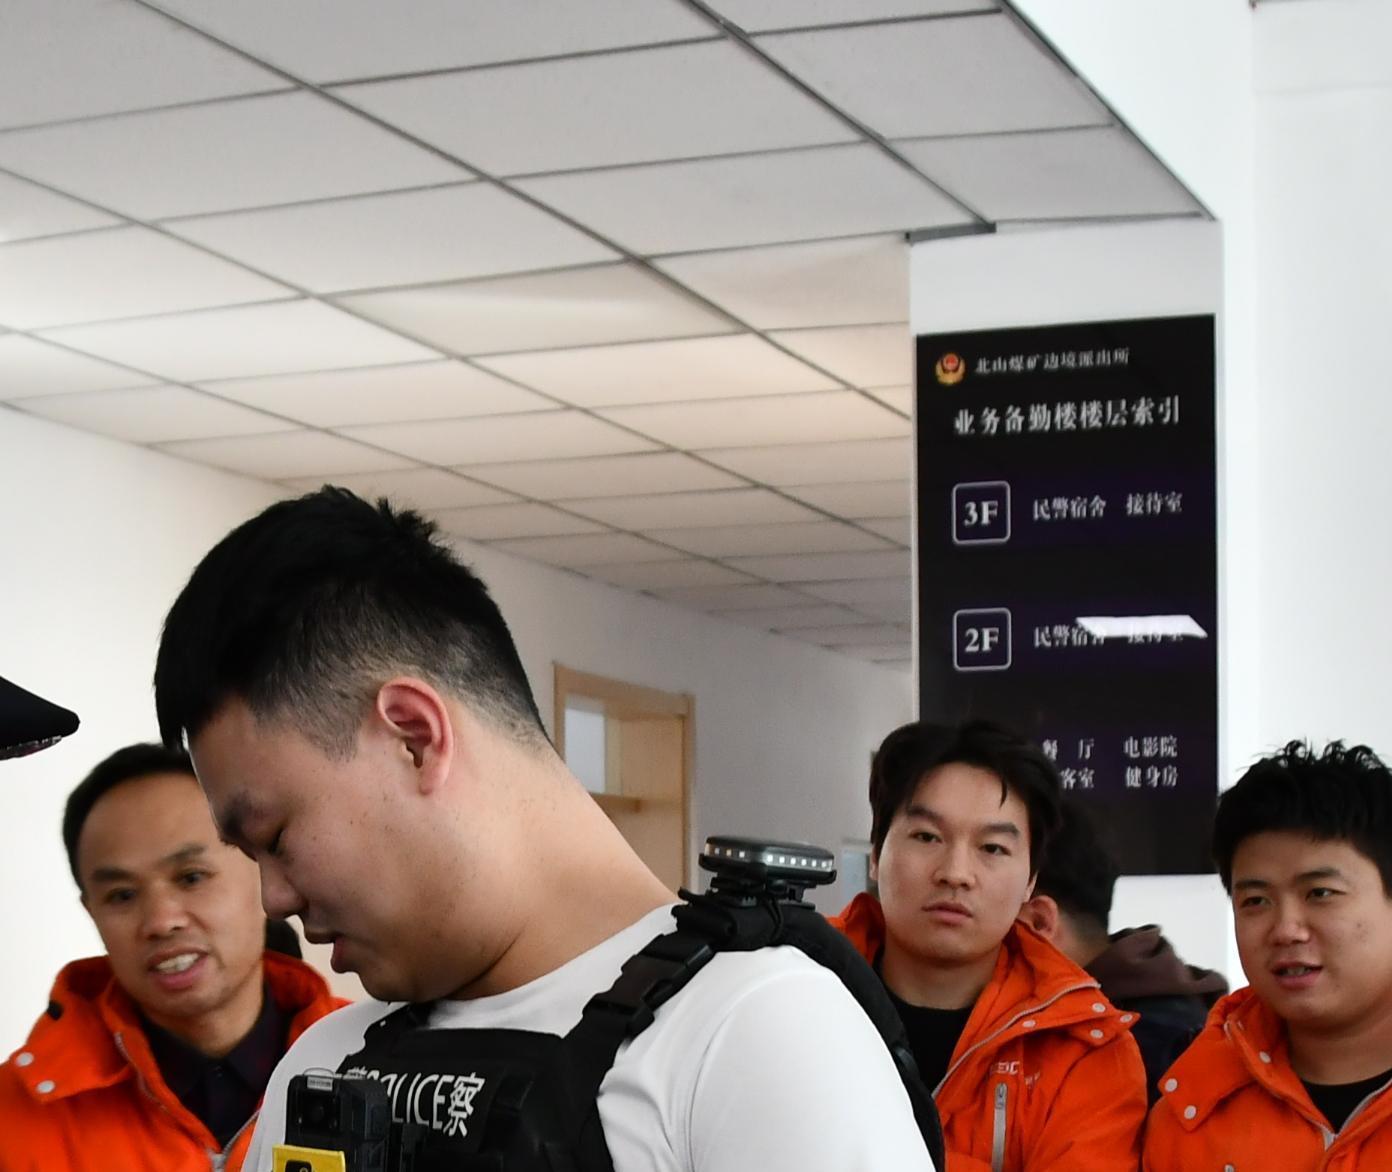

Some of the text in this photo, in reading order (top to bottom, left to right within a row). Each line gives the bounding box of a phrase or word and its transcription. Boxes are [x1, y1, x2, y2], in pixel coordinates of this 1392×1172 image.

[975, 347, 1130, 375] 北山煤矿边境派出所
[954, 395, 1179, 435] 业务备勤楼楼层索引
[964, 500, 998, 526] 3F
[1032, 491, 1183, 521] 民警宿舍 接待室
[964, 627, 1000, 652] 2F
[1124, 735, 1178, 758] 电影院
[1061, 765, 1179, 789] 客室 健身房
